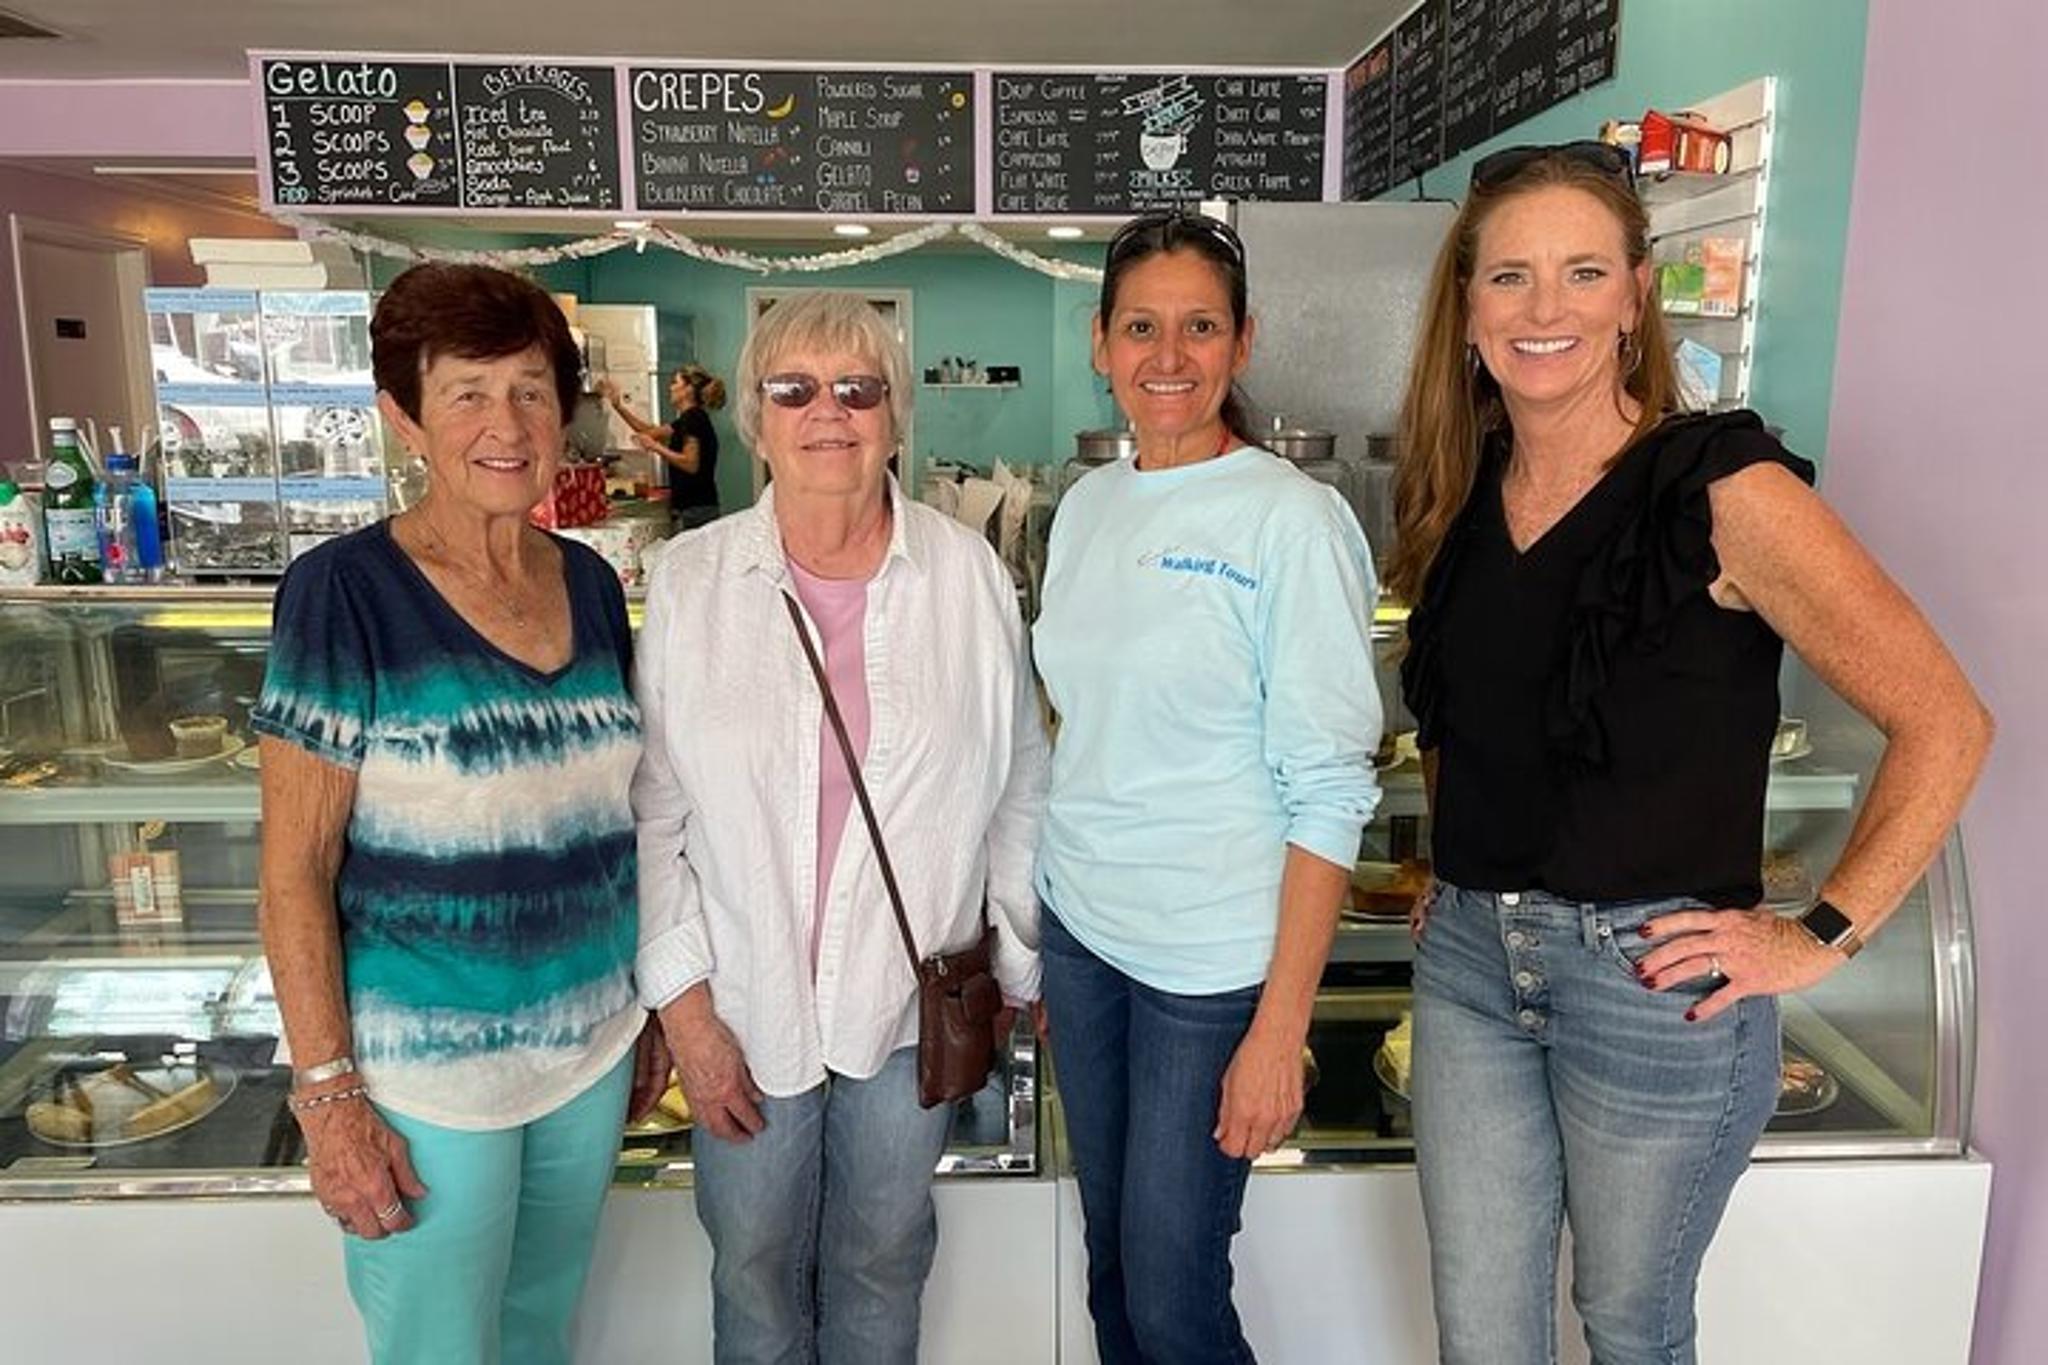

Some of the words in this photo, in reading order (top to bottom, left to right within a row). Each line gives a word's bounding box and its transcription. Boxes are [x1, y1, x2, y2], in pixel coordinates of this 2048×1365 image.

[267, 61, 398, 95] Gelato
[634, 71, 765, 113] CREPES
[272, 102, 291, 129] 1
[309, 103, 376, 126] SCOOP
[274, 130, 297, 157] 2
[312, 130, 391, 154] SCOOPS
[278, 160, 302, 185] 3
[317, 159, 388, 182] SCOOPS
[1161, 556, 1217, 575] Walking
[1218, 562, 1256, 589] Tours
